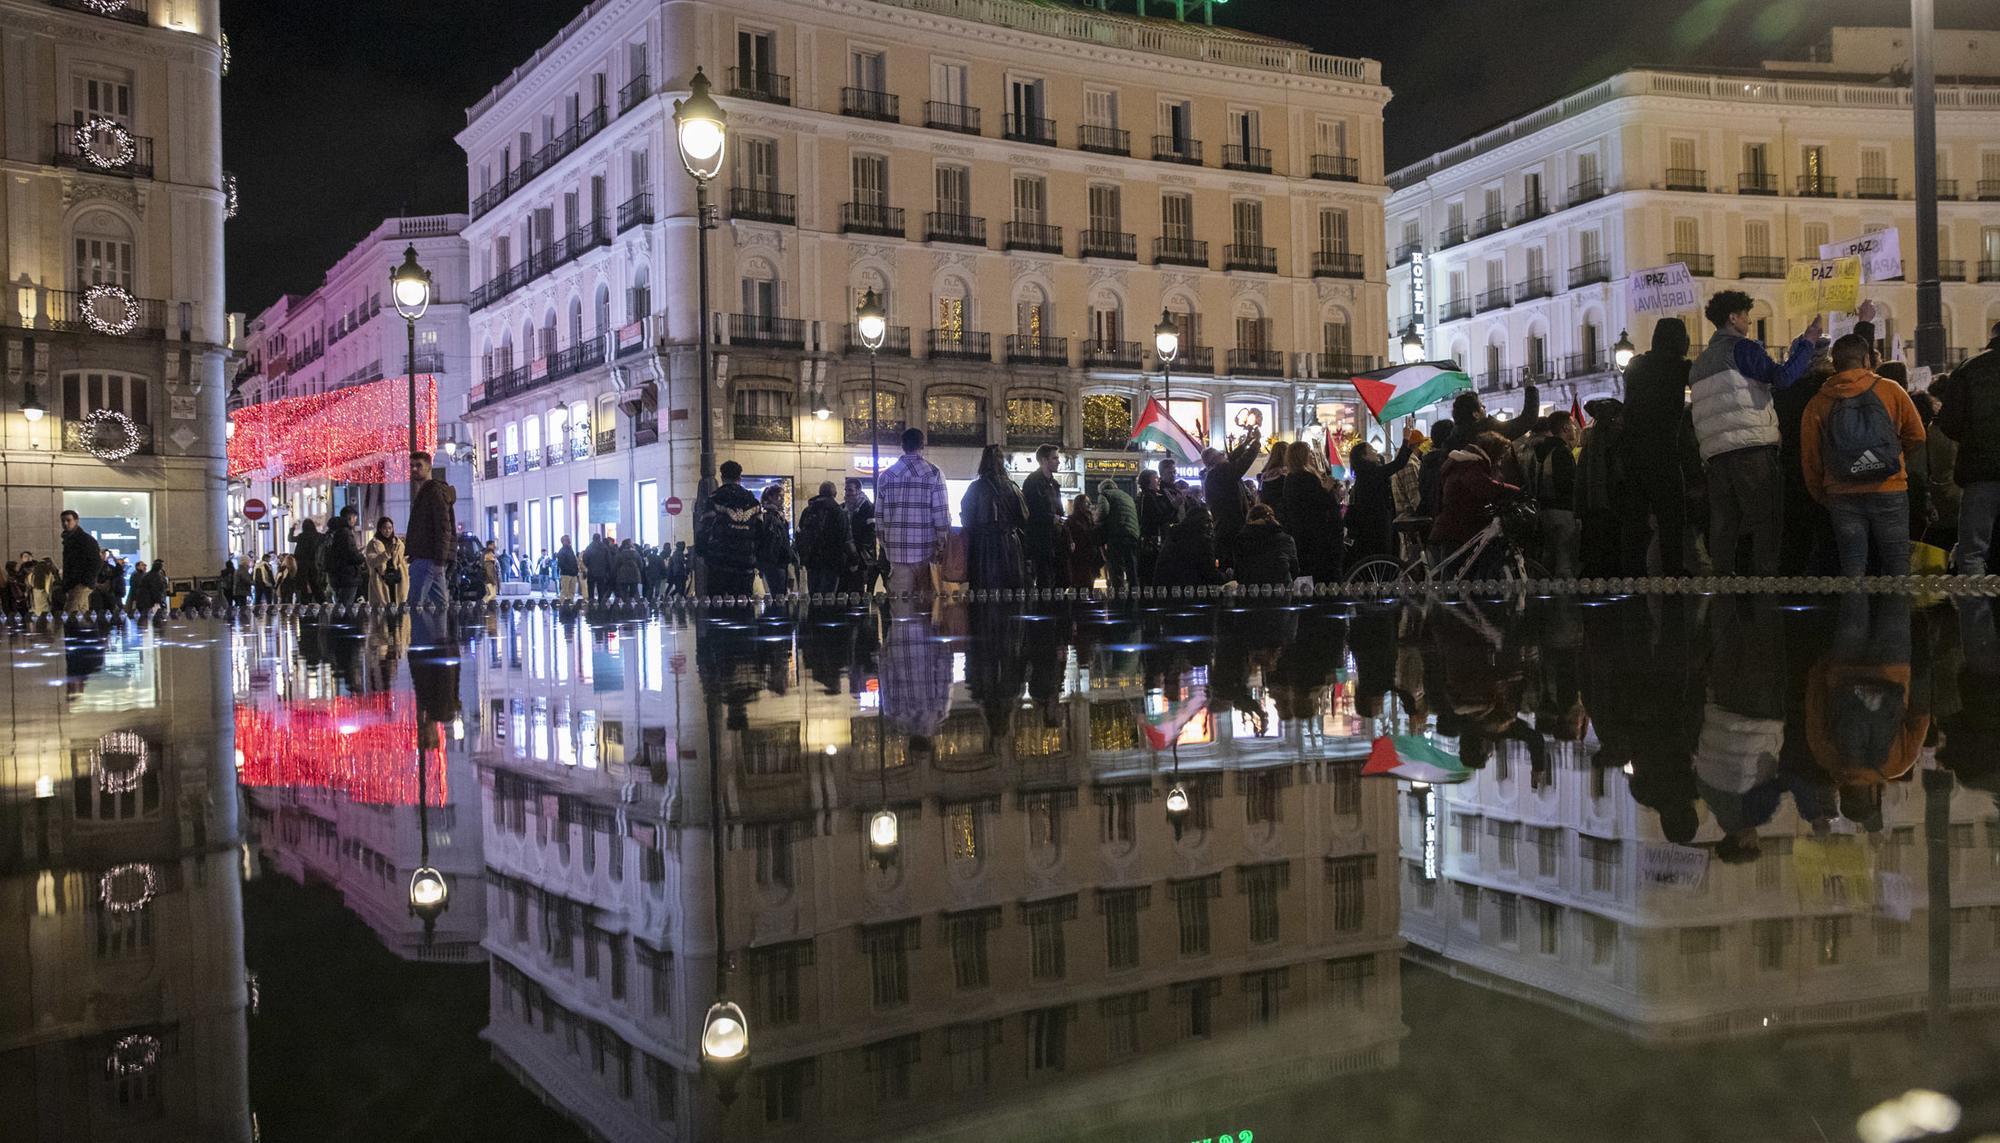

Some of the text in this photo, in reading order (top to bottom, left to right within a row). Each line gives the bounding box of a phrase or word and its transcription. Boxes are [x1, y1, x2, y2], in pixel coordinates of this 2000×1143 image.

[1849, 240, 1872, 255] PAZ
[1646, 272, 1665, 286] PAZ
[1811, 266, 1833, 280] PAZ
[1412, 252, 1424, 314] HOTEL
[1851, 461, 1886, 473] adidas
